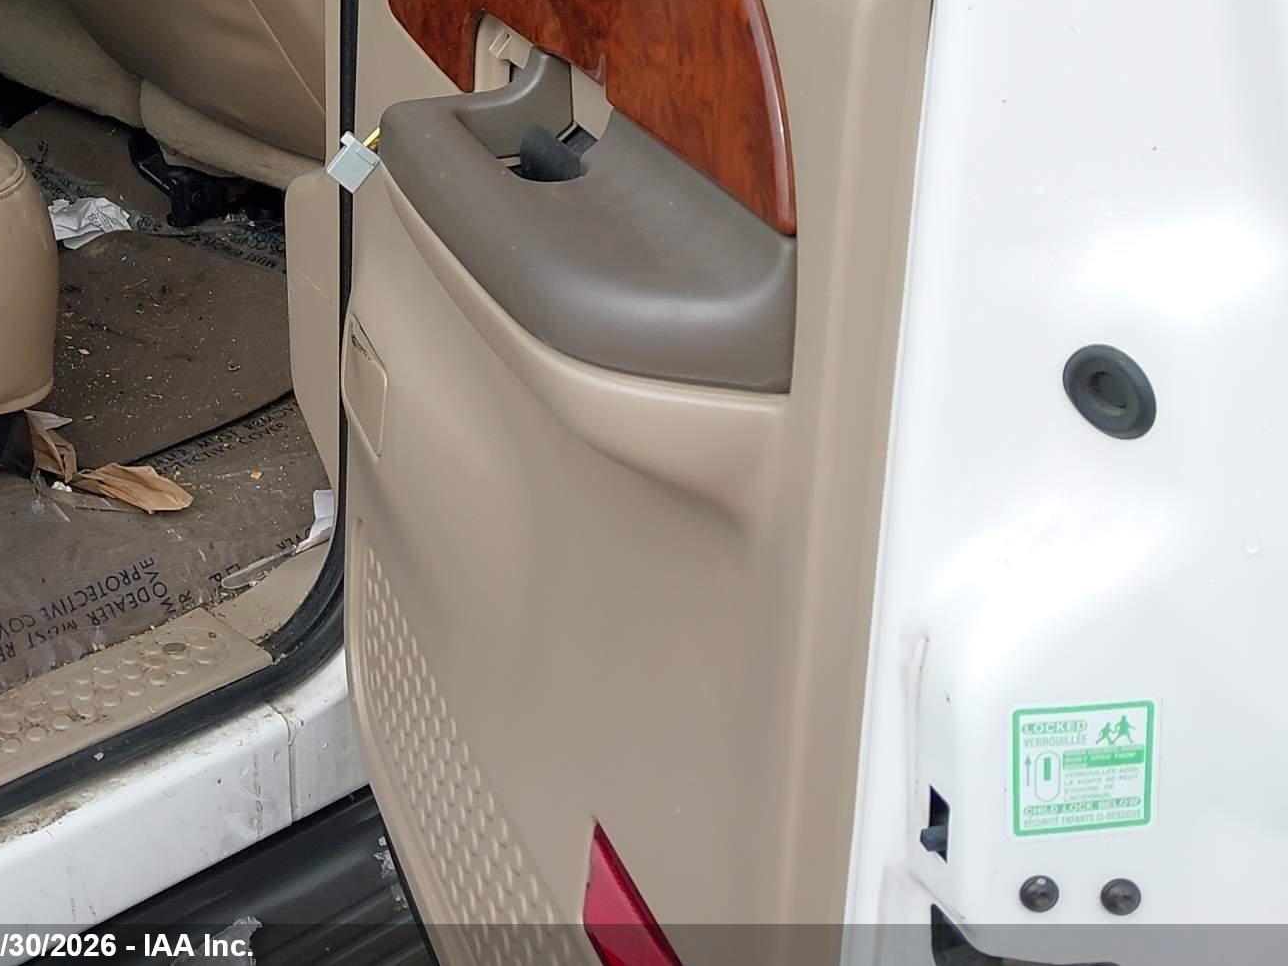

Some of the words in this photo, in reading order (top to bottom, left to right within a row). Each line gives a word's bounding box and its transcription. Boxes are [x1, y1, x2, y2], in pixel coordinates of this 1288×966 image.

[40, 564, 142, 621] PROTECTIVE
[86, 586, 151, 626] DEALER
[1023, 721, 1086, 734] LOCKED
[1025, 805, 1059, 816] CHILD
[1063, 801, 1094, 813] LOCK
[1098, 797, 1141, 809] BELOW
